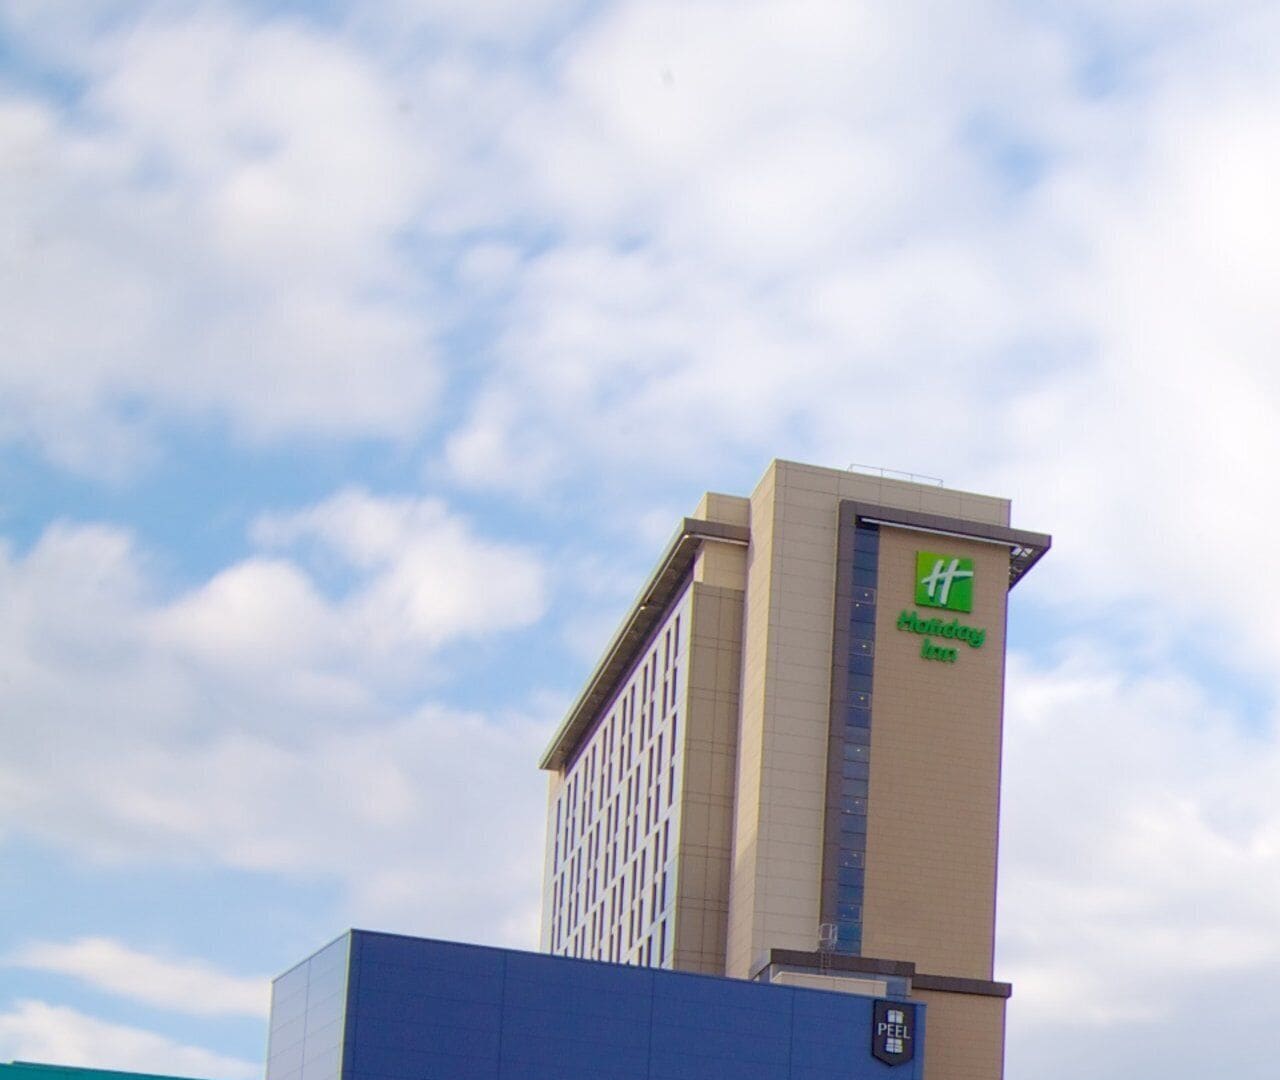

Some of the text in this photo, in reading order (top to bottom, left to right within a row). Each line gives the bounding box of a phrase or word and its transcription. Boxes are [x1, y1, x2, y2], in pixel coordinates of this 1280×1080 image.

[896, 610, 986, 648] Holiday
[920, 639, 958, 663] Inn
[877, 1022, 911, 1039] PEEL
